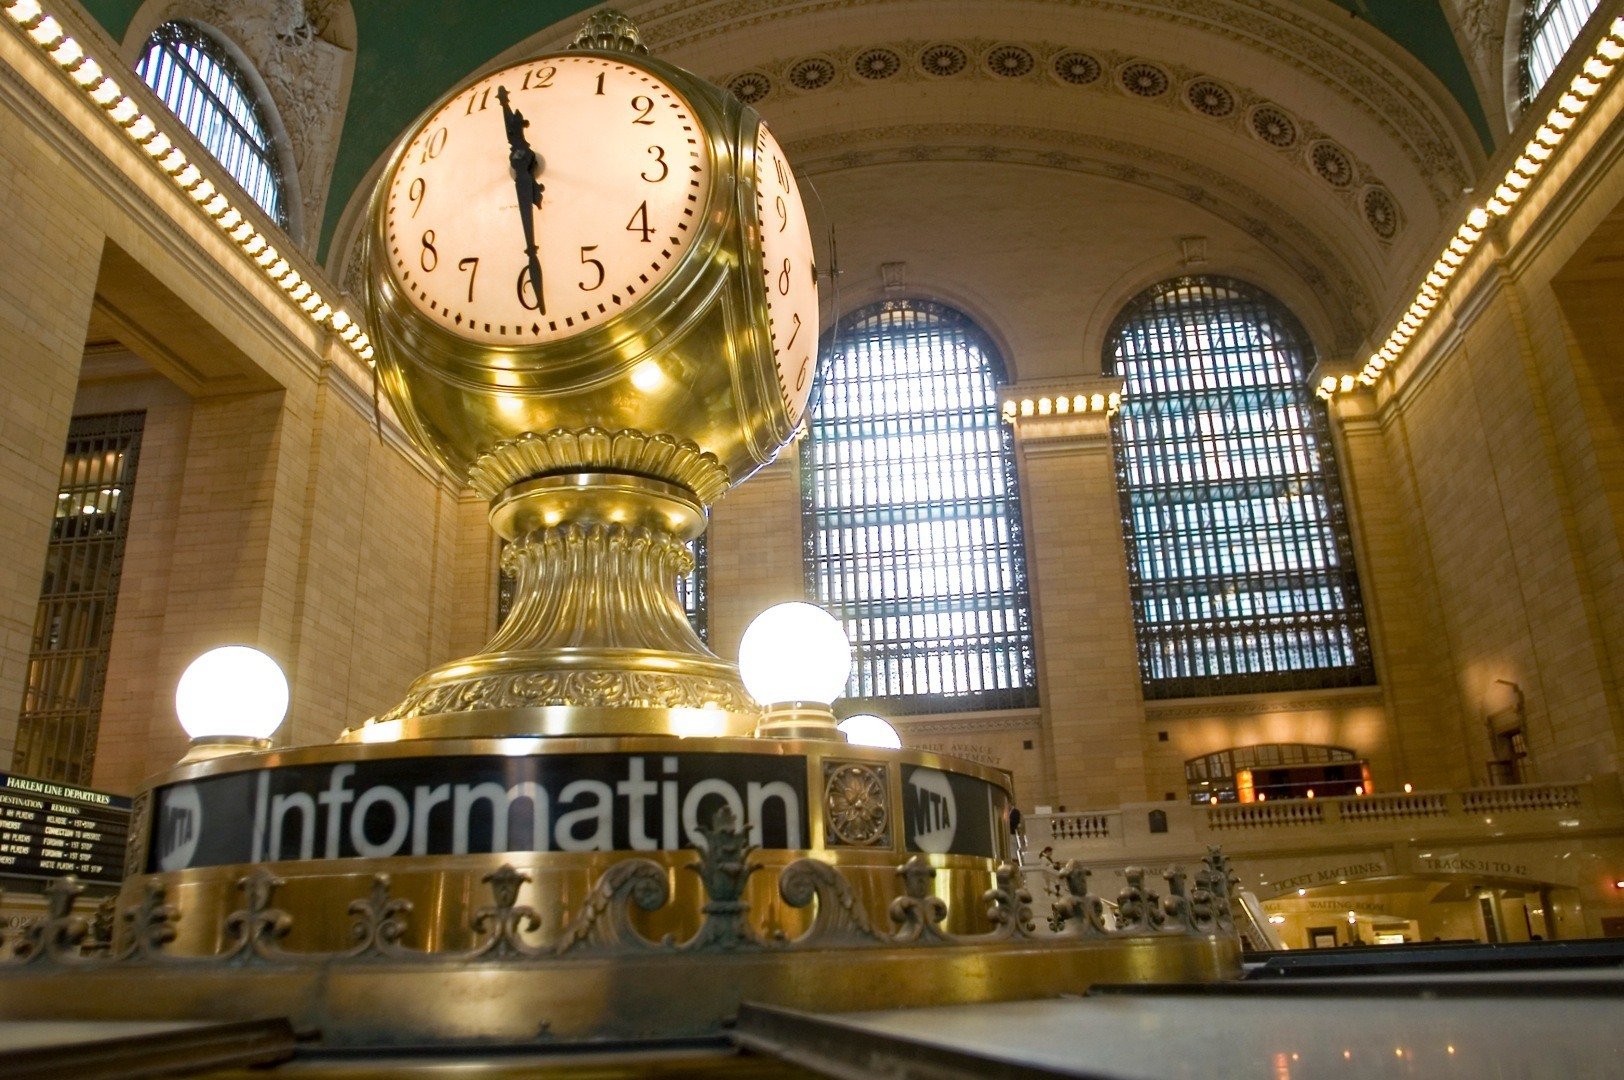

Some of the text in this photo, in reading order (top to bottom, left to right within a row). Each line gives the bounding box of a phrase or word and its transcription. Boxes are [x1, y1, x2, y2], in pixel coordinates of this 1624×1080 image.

[521, 66, 557, 90] 12
[595, 72, 605, 95] 1
[464, 87, 489, 116] 11
[630, 95, 655, 125] 2
[418, 127, 448, 164] 10
[640, 146, 669, 183] 3
[773, 156, 790, 194] 10
[409, 177, 426, 219] 9
[776, 195, 787, 233] 9
[625, 200, 656, 243] 4
[420, 230, 438, 273] 8
[578, 245, 605, 291] 5
[457, 257, 479, 303] 7
[516, 264, 543, 311] 6
[778, 258, 791, 296] 8
[788, 312, 801, 350] 7
[796, 356, 809, 392] 6
[0, 795, 44, 809] DESTINATION
[7, 777, 111, 805] HARLEM LINE DEPARTURES
[51, 803, 80, 815] REMARKS
[908, 781, 951, 837] MTA
[252, 757, 800, 863] Information
[1270, 862, 1383, 892] TICKET MACHINES
[1427, 859, 1527, 875] TRACKS 31 TO 42
[1308, 900, 1353, 910] WAITING
